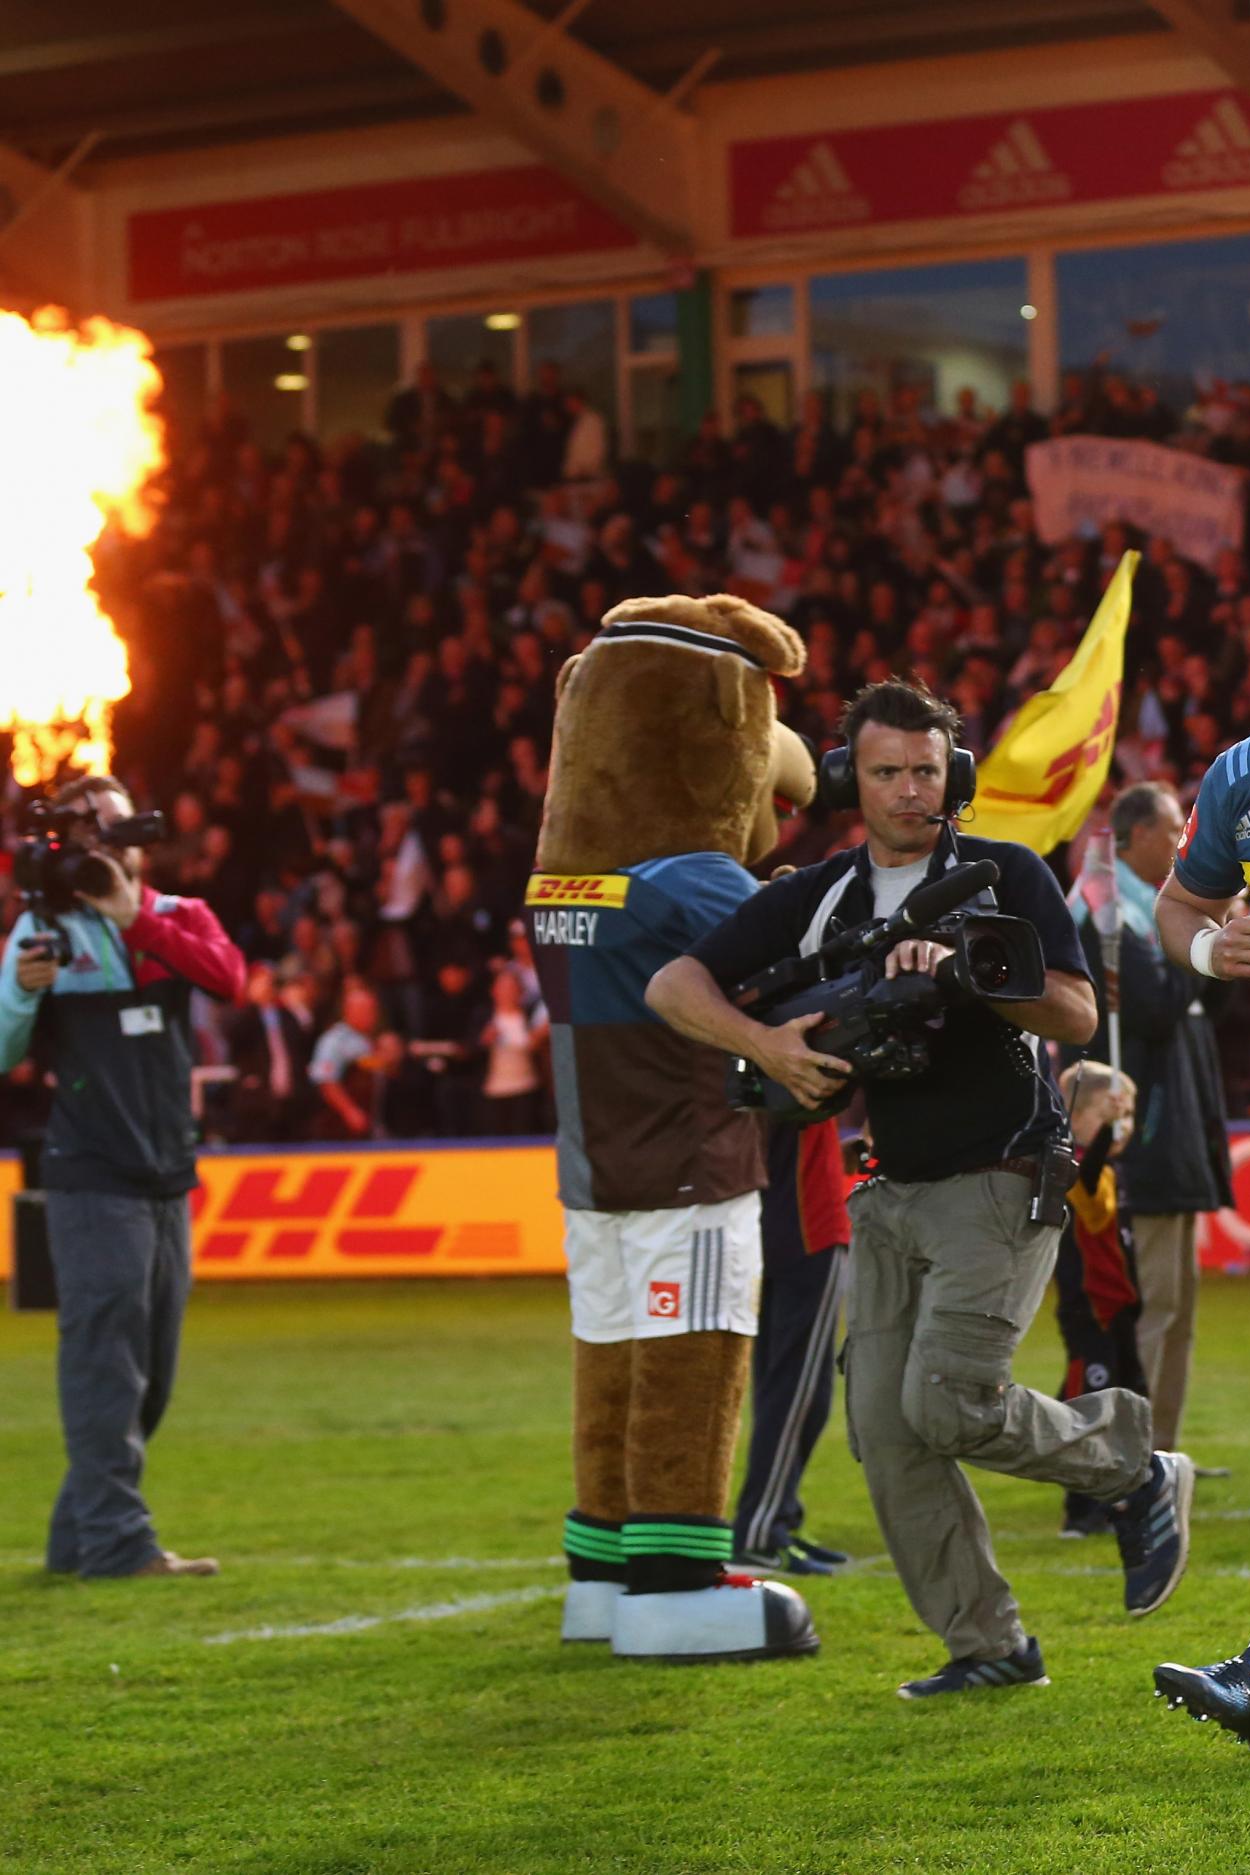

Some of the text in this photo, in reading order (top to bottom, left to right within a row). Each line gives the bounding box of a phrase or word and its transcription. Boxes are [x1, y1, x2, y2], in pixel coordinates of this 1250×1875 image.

[536, 879, 606, 900] DHL
[533, 910, 600, 946] HARLEY
[190, 1166, 445, 1259] HL
[648, 1290, 676, 1315] IG
